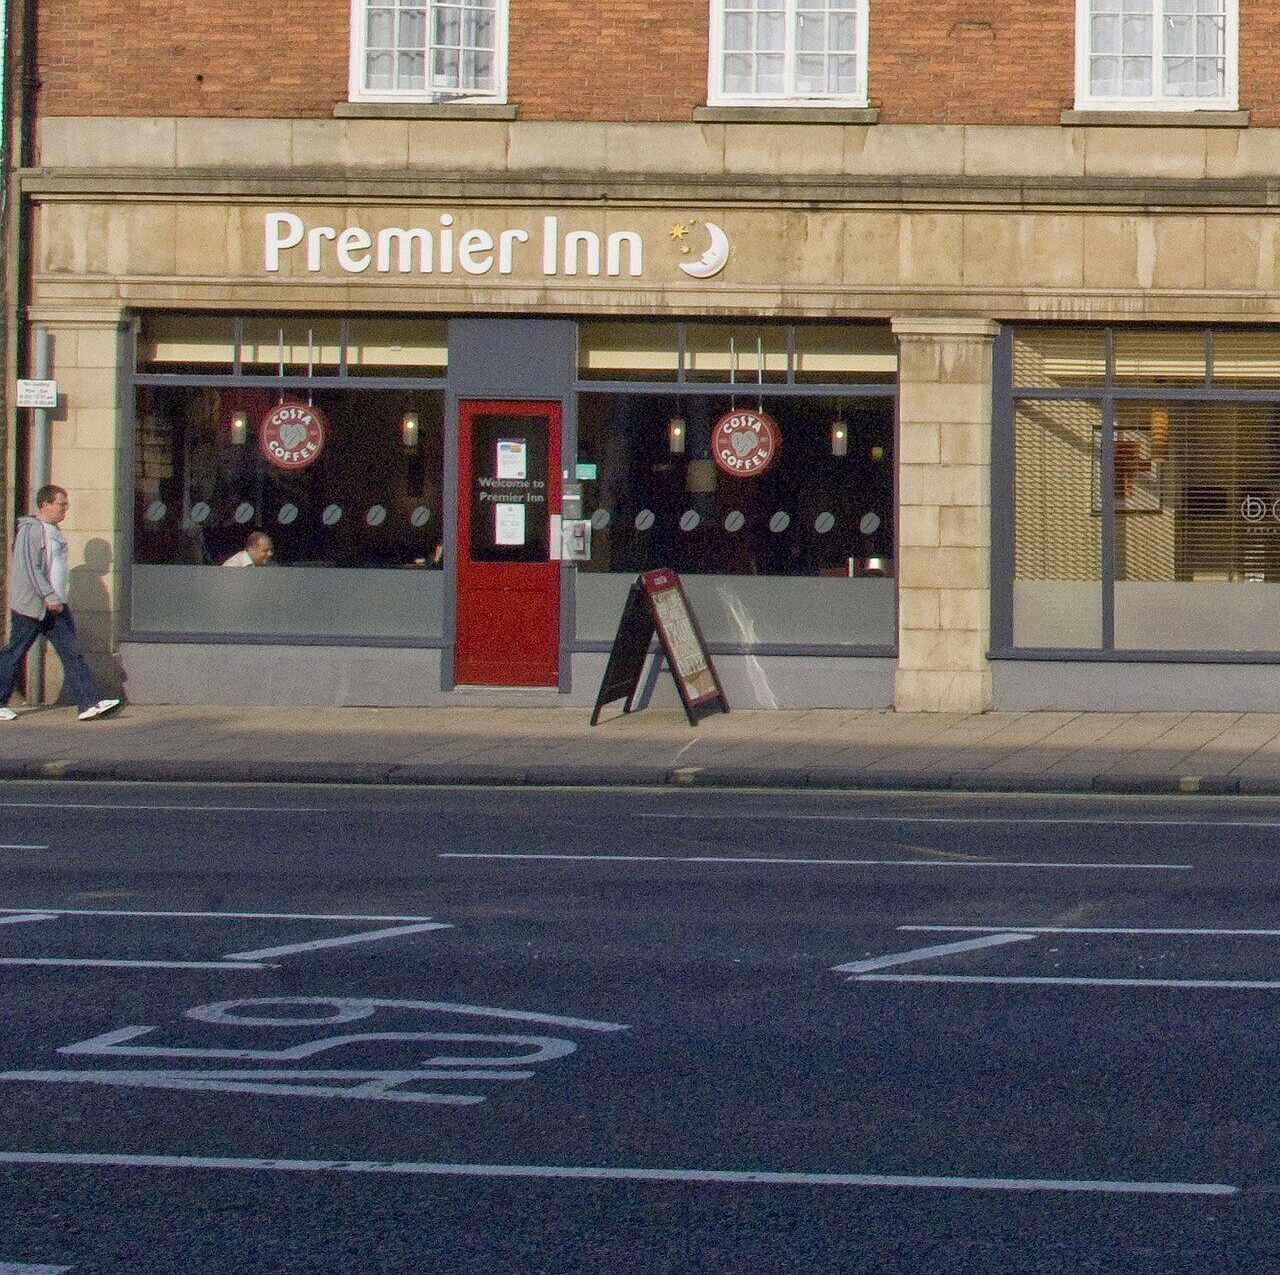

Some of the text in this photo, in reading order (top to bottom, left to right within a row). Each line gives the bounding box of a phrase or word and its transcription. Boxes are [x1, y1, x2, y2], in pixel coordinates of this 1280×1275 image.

[264, 212, 643, 276] Premier Inn
[272, 408, 312, 426] COSTA
[723, 415, 762, 433] COSTA
[269, 440, 317, 462] COFFEE
[721, 448, 768, 470] COFFEE
[478, 477, 545, 488] Welcome to
[479, 492, 544, 502] Premier Inn
